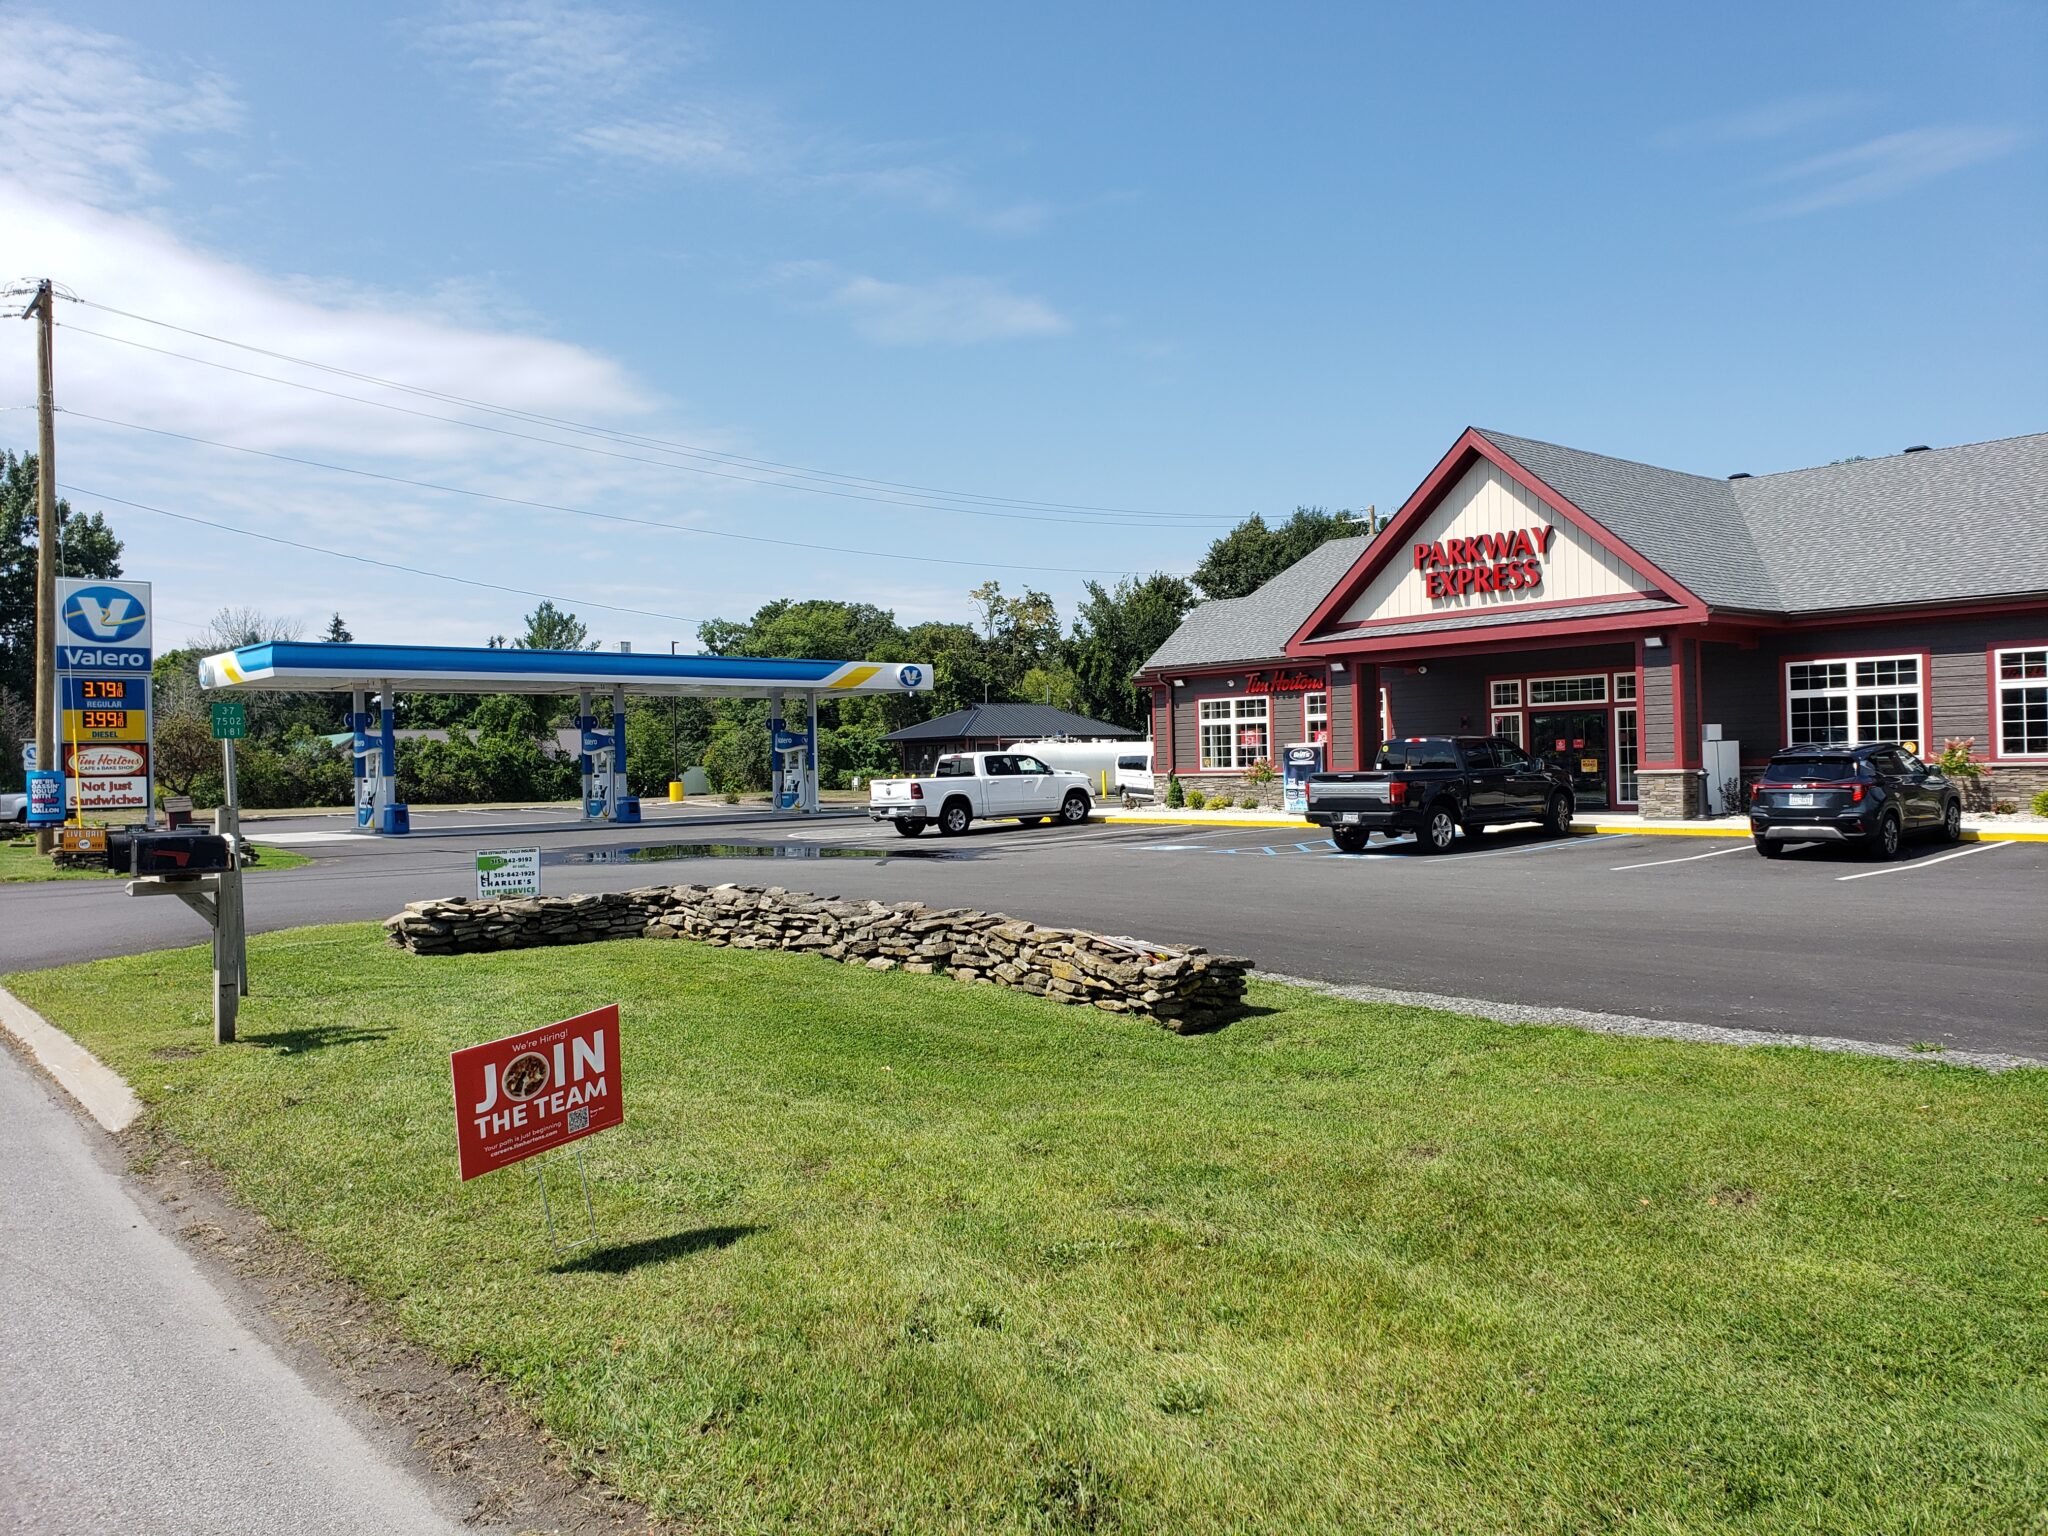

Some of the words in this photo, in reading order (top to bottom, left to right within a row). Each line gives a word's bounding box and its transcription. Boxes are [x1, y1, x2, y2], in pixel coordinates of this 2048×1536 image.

[1414, 525, 1553, 570] PARKWAY
[1426, 559, 1541, 598] EXPRESS
[64, 649, 144, 666] Valero
[1245, 672, 1269, 693] Tim
[1270, 670, 1324, 692] Hortons
[77, 754, 95, 765] Tim
[98, 754, 140, 766] Hortons
[82, 782, 106, 791] Not
[109, 782, 133, 792] Just
[70, 794, 144, 806] Sandwiches
[66, 830, 83, 838] LIVE
[480, 879, 532, 888] CHARLIE'S
[512, 1039, 537, 1052] We're
[540, 1028, 568, 1044] Hiring!
[474, 1104, 527, 1139] THE
[534, 1077, 607, 1119] TEAM
[532, 1121, 562, 1135] beginning
